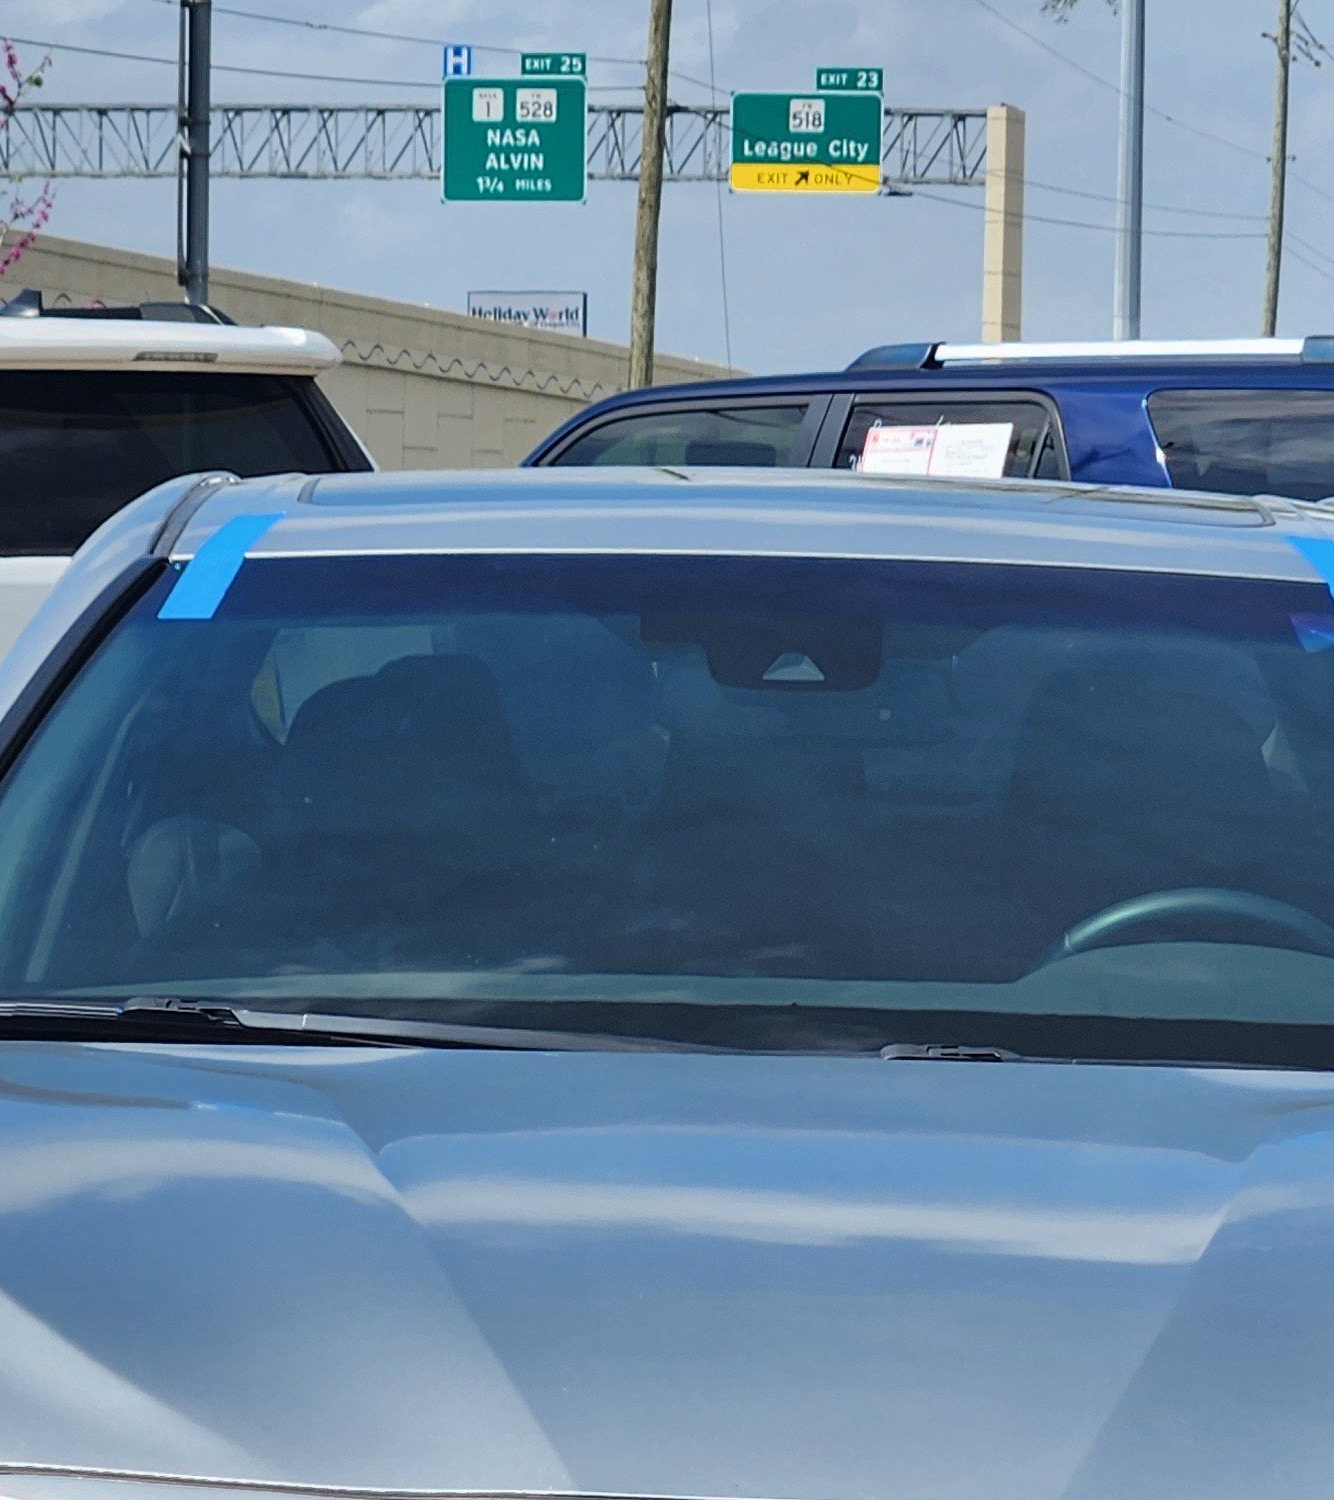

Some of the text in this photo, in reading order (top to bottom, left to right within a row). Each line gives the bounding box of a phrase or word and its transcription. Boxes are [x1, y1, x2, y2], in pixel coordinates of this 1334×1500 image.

[525, 56, 582, 73] EXIT 25
[820, 71, 879, 88] EXIT 23
[519, 101, 554, 118] 528
[792, 111, 822, 129] 518
[487, 128, 540, 148] NASA
[743, 138, 869, 163] League City
[485, 152, 544, 172] ALVIN
[515, 178, 552, 192] MILES
[757, 172, 854, 185] EXIT ONLY
